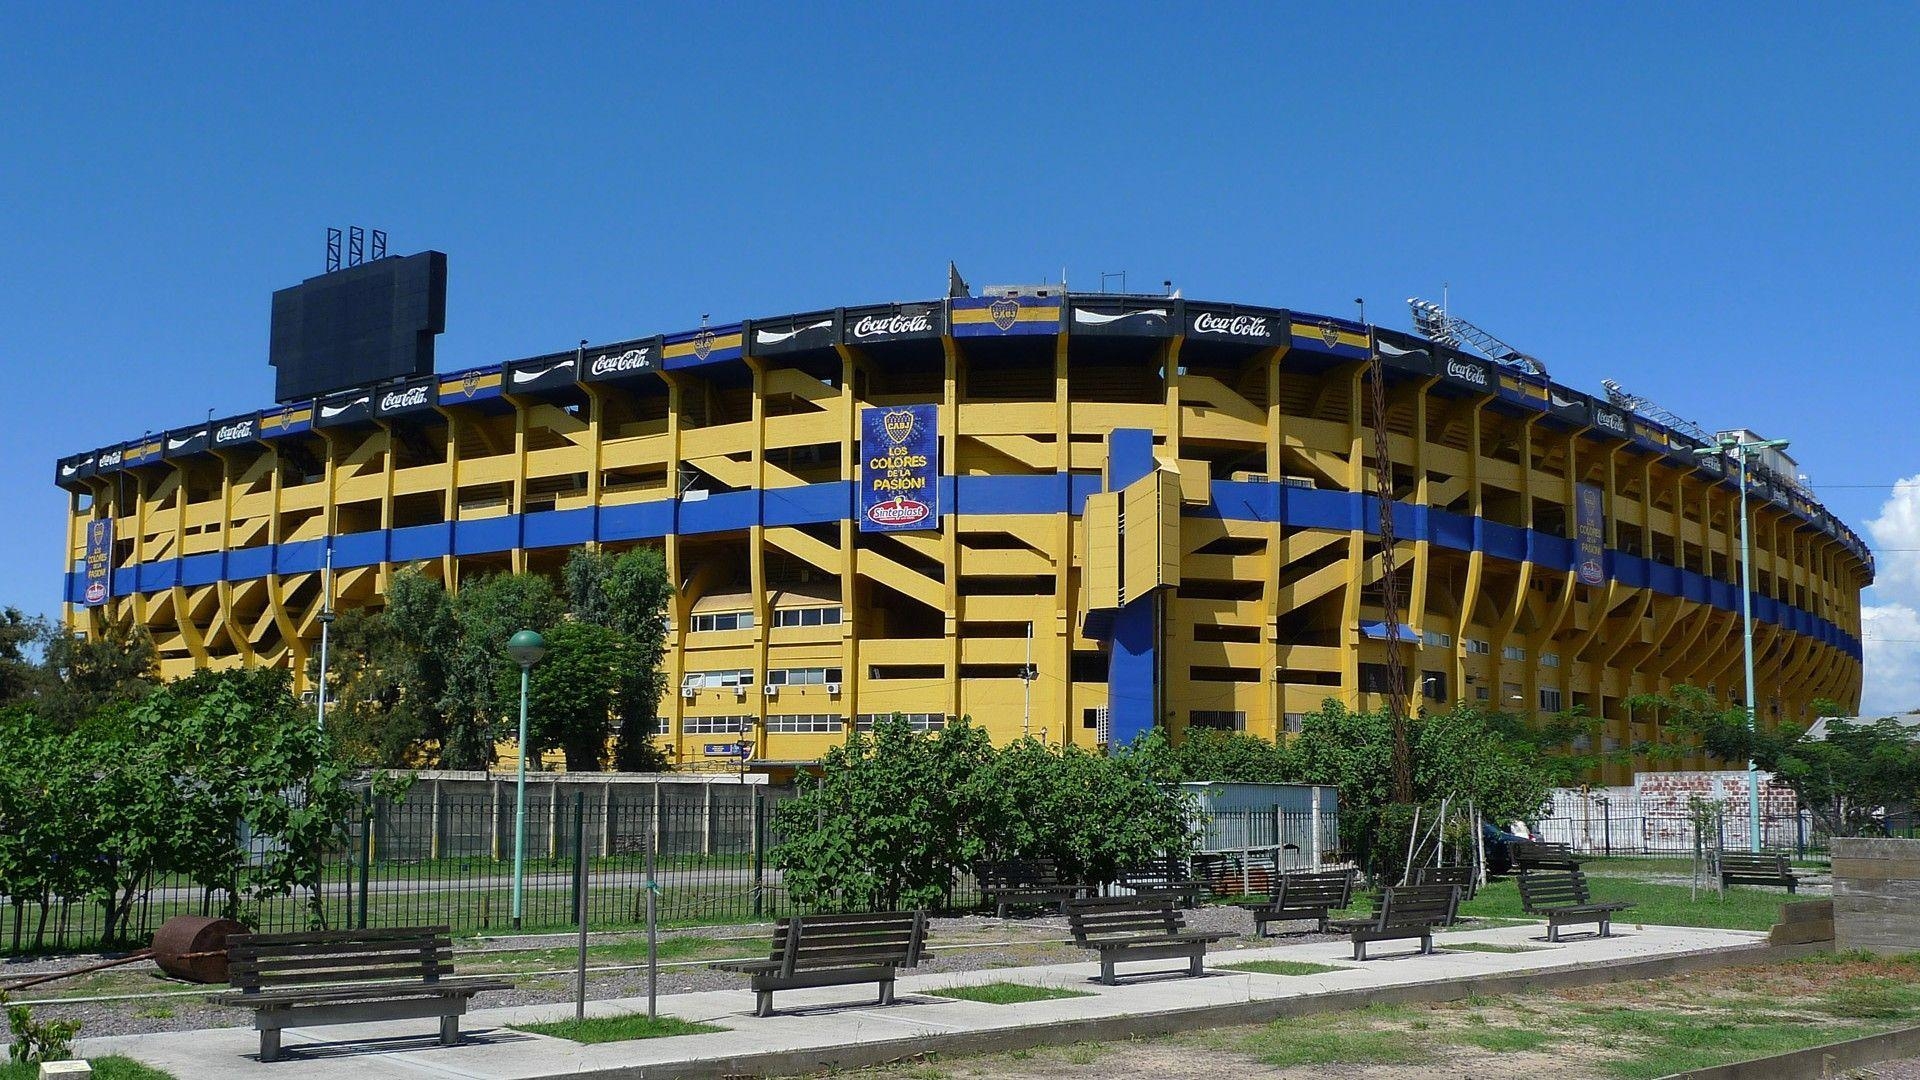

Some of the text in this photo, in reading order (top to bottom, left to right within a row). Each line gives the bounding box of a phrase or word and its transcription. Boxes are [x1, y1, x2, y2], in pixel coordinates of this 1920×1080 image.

[854, 311, 929, 338] Coca-Cola
[1194, 312, 1267, 337] Coca-Cola
[592, 347, 649, 376] Coca-Cola
[381, 386, 428, 411] Coca-Cola
[888, 422, 909, 430] CABJ
[889, 447, 908, 456] LOS
[870, 456, 927, 469] COLORES
[899, 469, 911, 477] LA
[873, 506, 924, 518] Sinteplast
